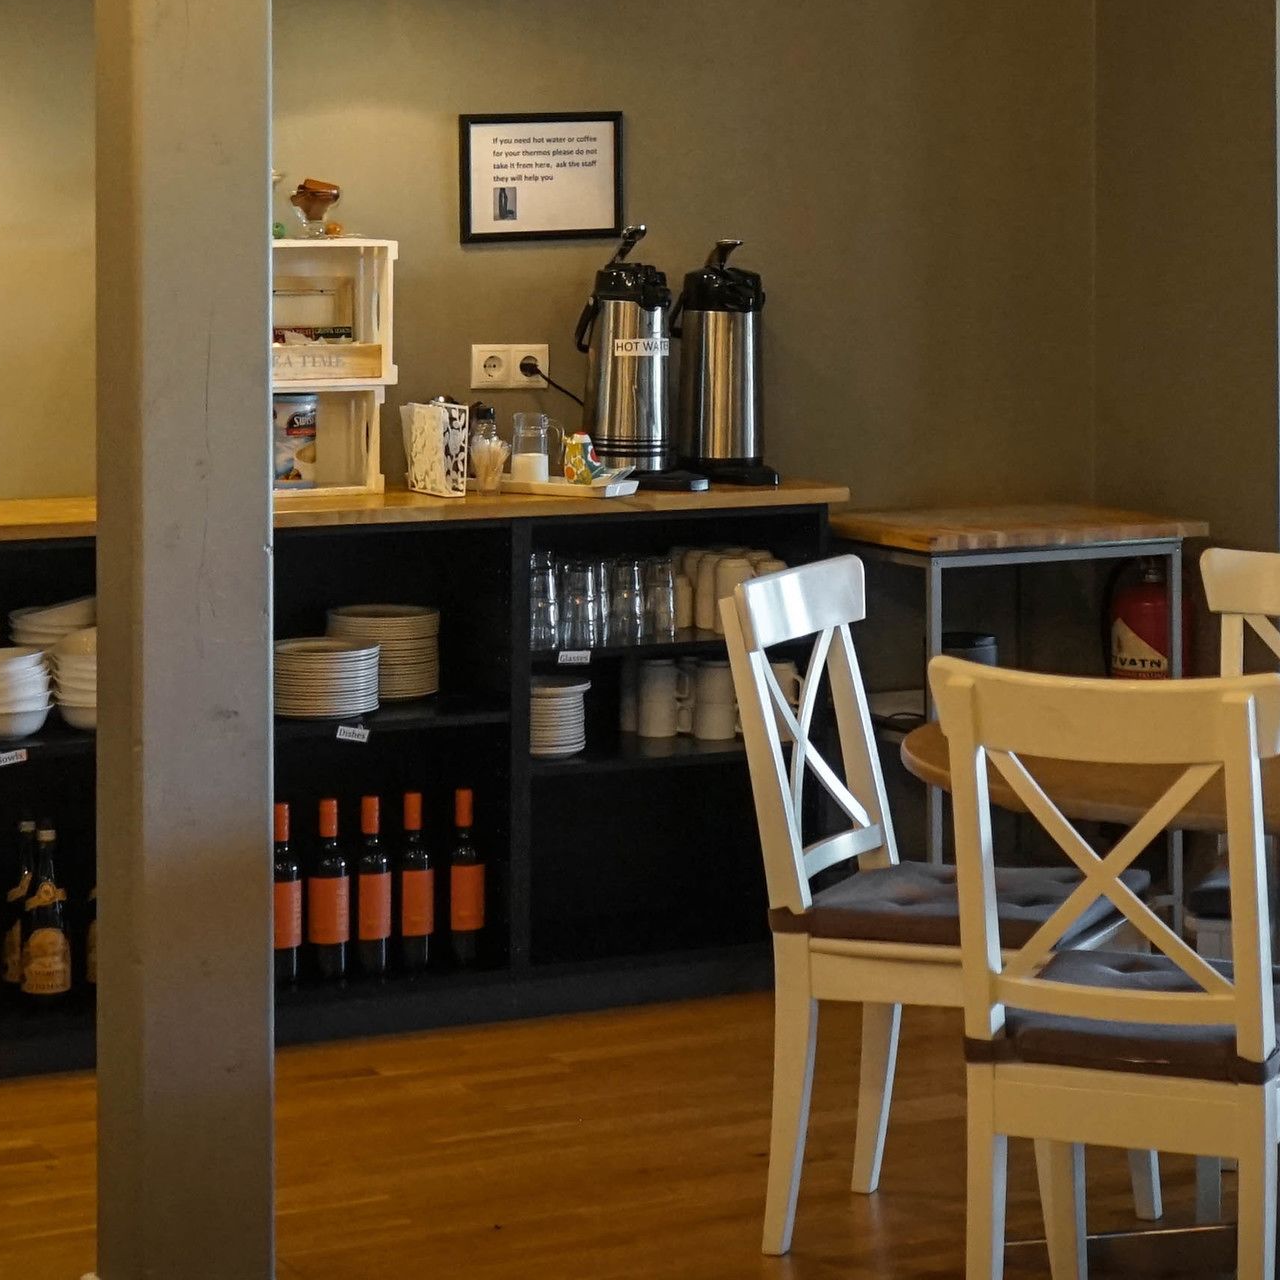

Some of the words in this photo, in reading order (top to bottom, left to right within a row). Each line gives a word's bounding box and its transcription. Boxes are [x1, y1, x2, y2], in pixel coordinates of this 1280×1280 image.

[616, 342, 640, 352] HOT
[642, 341, 669, 352] WATE
[272, 354, 292, 368] EA
[302, 354, 343, 368] TIME
